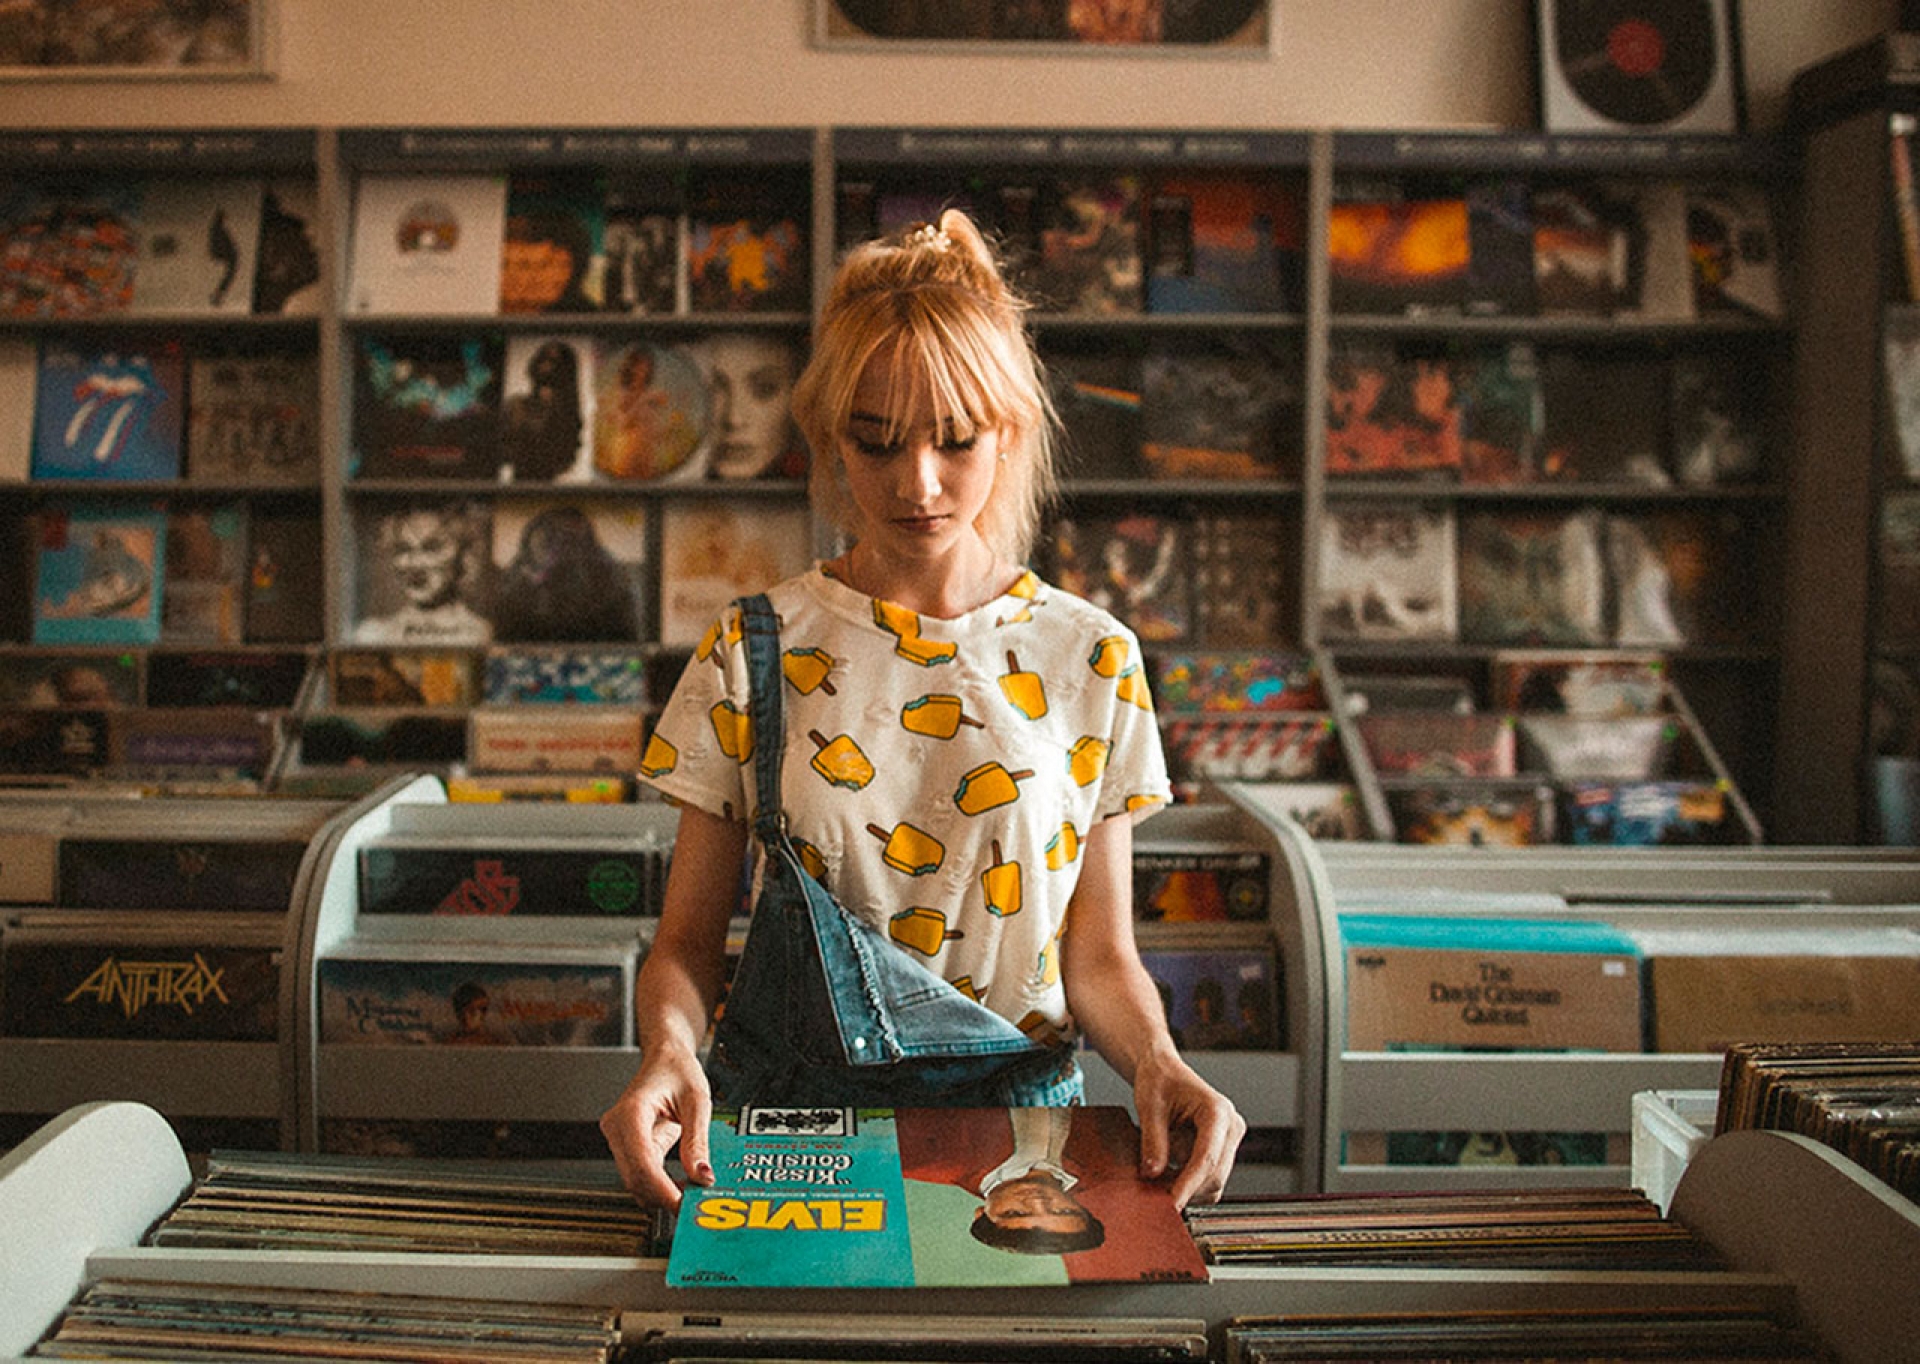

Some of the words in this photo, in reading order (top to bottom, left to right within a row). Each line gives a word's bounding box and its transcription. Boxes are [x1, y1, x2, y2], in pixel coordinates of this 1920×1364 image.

[64, 951, 229, 1019] ANTHRAX
[1478, 962, 1513, 982] The
[694, 1198, 888, 1231] ELVIS
